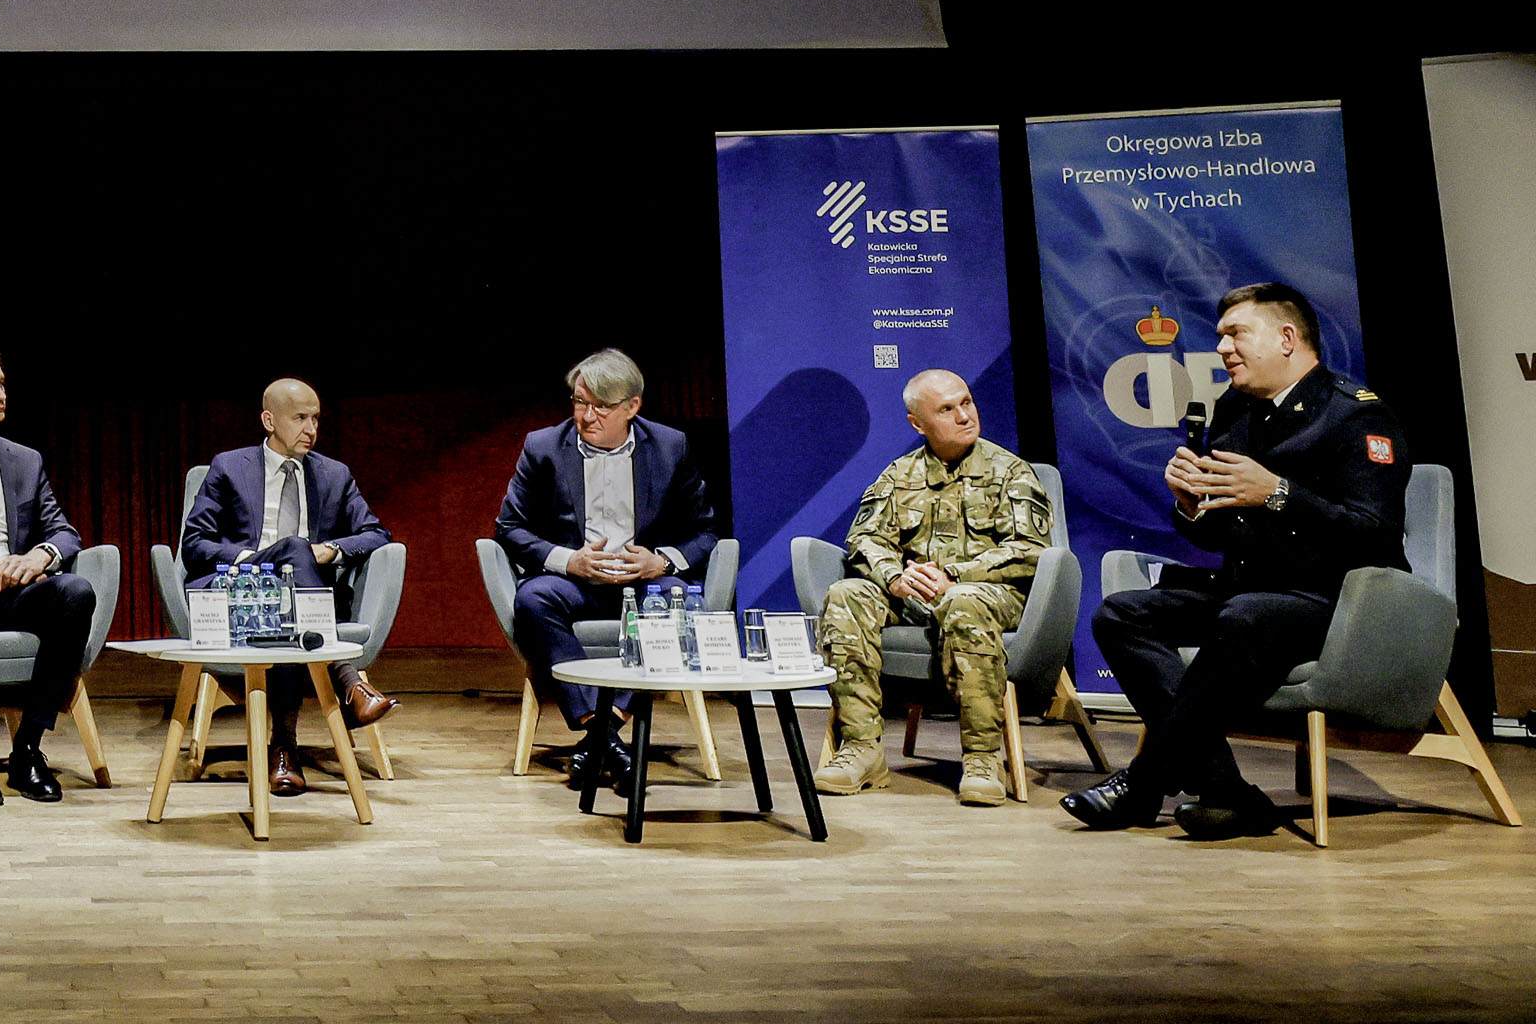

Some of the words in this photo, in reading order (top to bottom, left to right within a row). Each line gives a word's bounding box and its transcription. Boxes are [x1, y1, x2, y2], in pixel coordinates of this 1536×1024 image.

[1106, 133, 1213, 155] Okręgowa
[1219, 129, 1263, 147] Izba
[1062, 157, 1316, 185] Przemysłowo-Handlowa
[1131, 197, 1149, 210] w
[1154, 189, 1242, 213] Tychach
[866, 209, 949, 234] KSSE
[867, 242, 918, 252] Katowicka
[868, 253, 915, 264] Specjalna
[917, 252, 947, 263] Strefa
[868, 266, 933, 275] Ekonomiczna
[872, 306, 955, 318] www.ksse.com.pl
[873, 319, 950, 330] @KatowickaSSE
